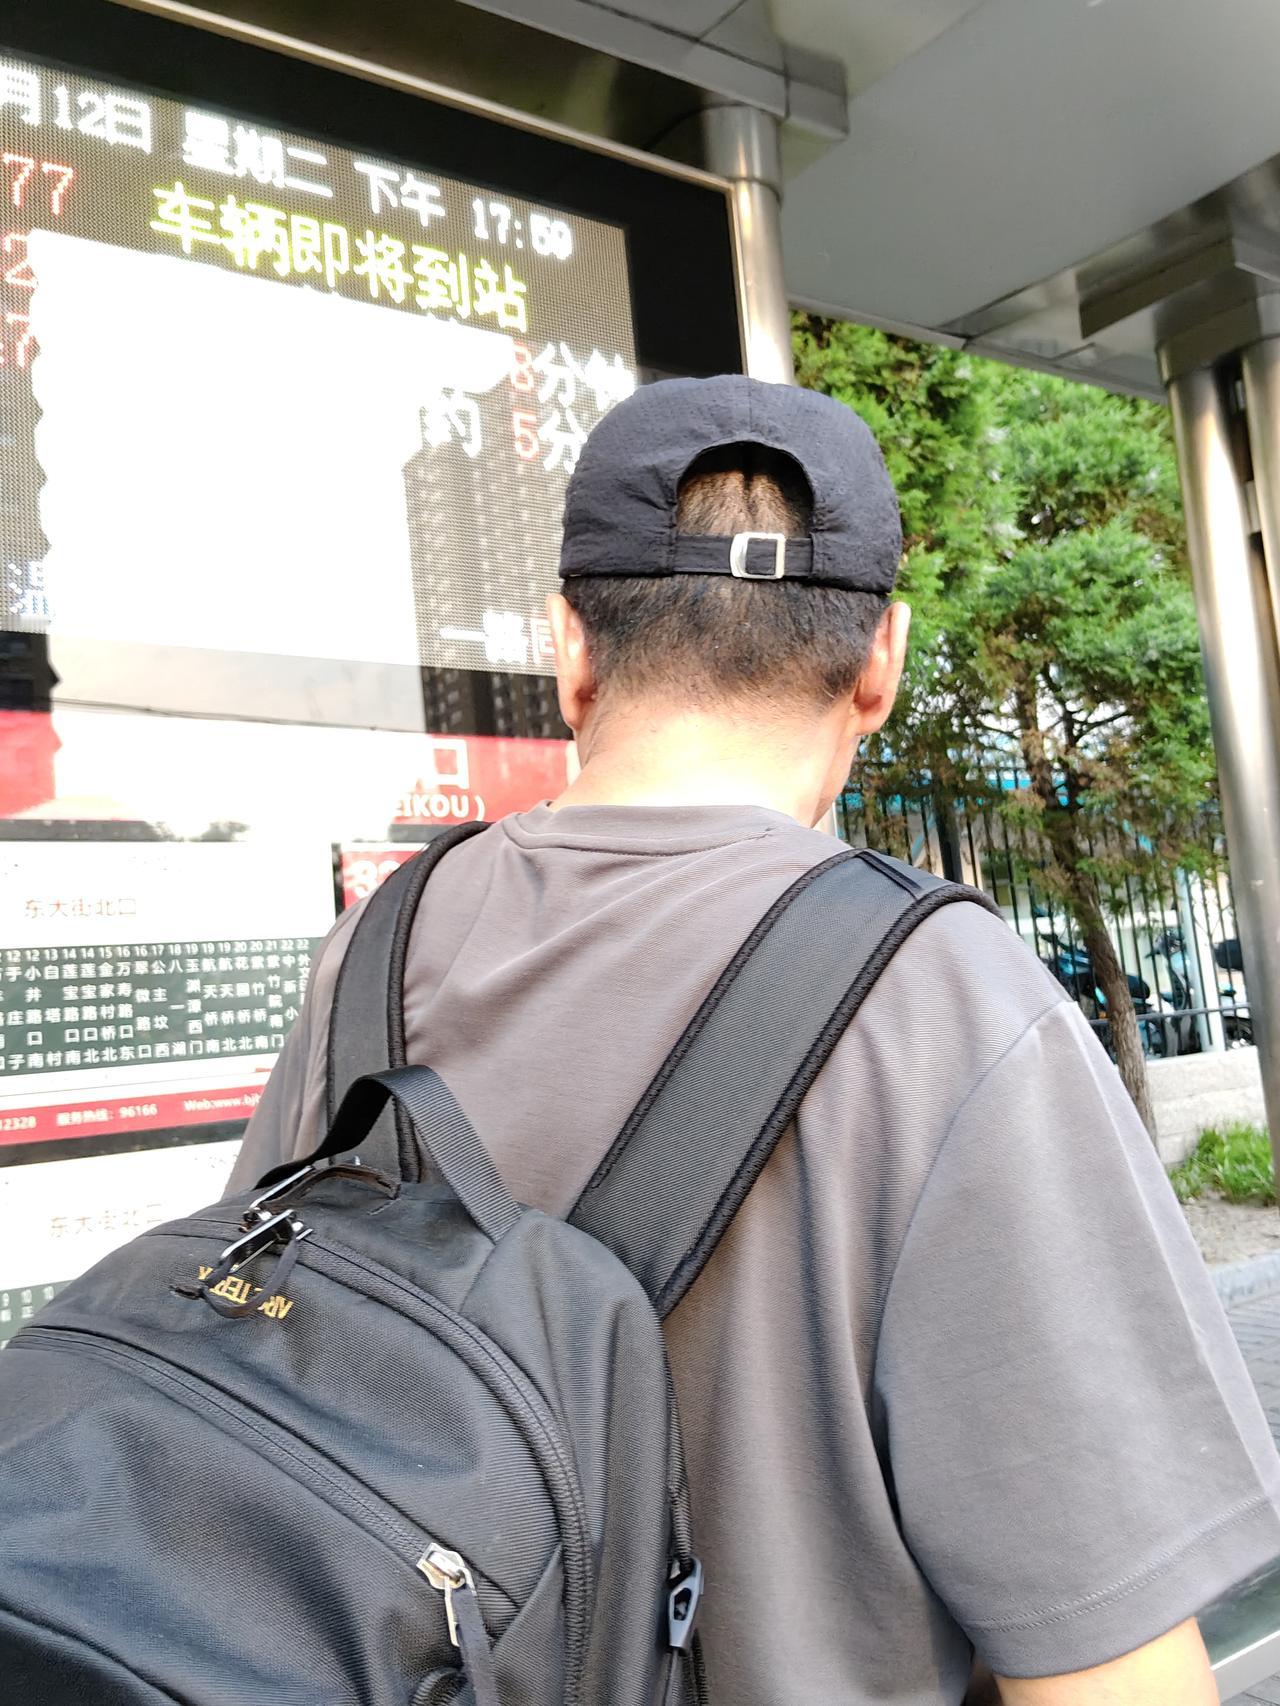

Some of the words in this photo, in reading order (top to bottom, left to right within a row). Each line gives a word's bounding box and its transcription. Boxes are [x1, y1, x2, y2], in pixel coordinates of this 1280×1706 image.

[182, 110, 334, 197] 星期二
[353, 161, 446, 227] 下午
[149, 180, 529, 333] 车辆即将到站
[116, 961, 135, 1060] 万寿路口东
[151, 960, 170, 1058] 公主坟西
[168, 959, 187, 1056] 八一湖
[202, 957, 220, 1053] 航天桥南
[218, 957, 237, 1052] 航天桥北
[234, 956, 253, 1050] 花园桥北
[198, 1265, 294, 1319] ARTERX
